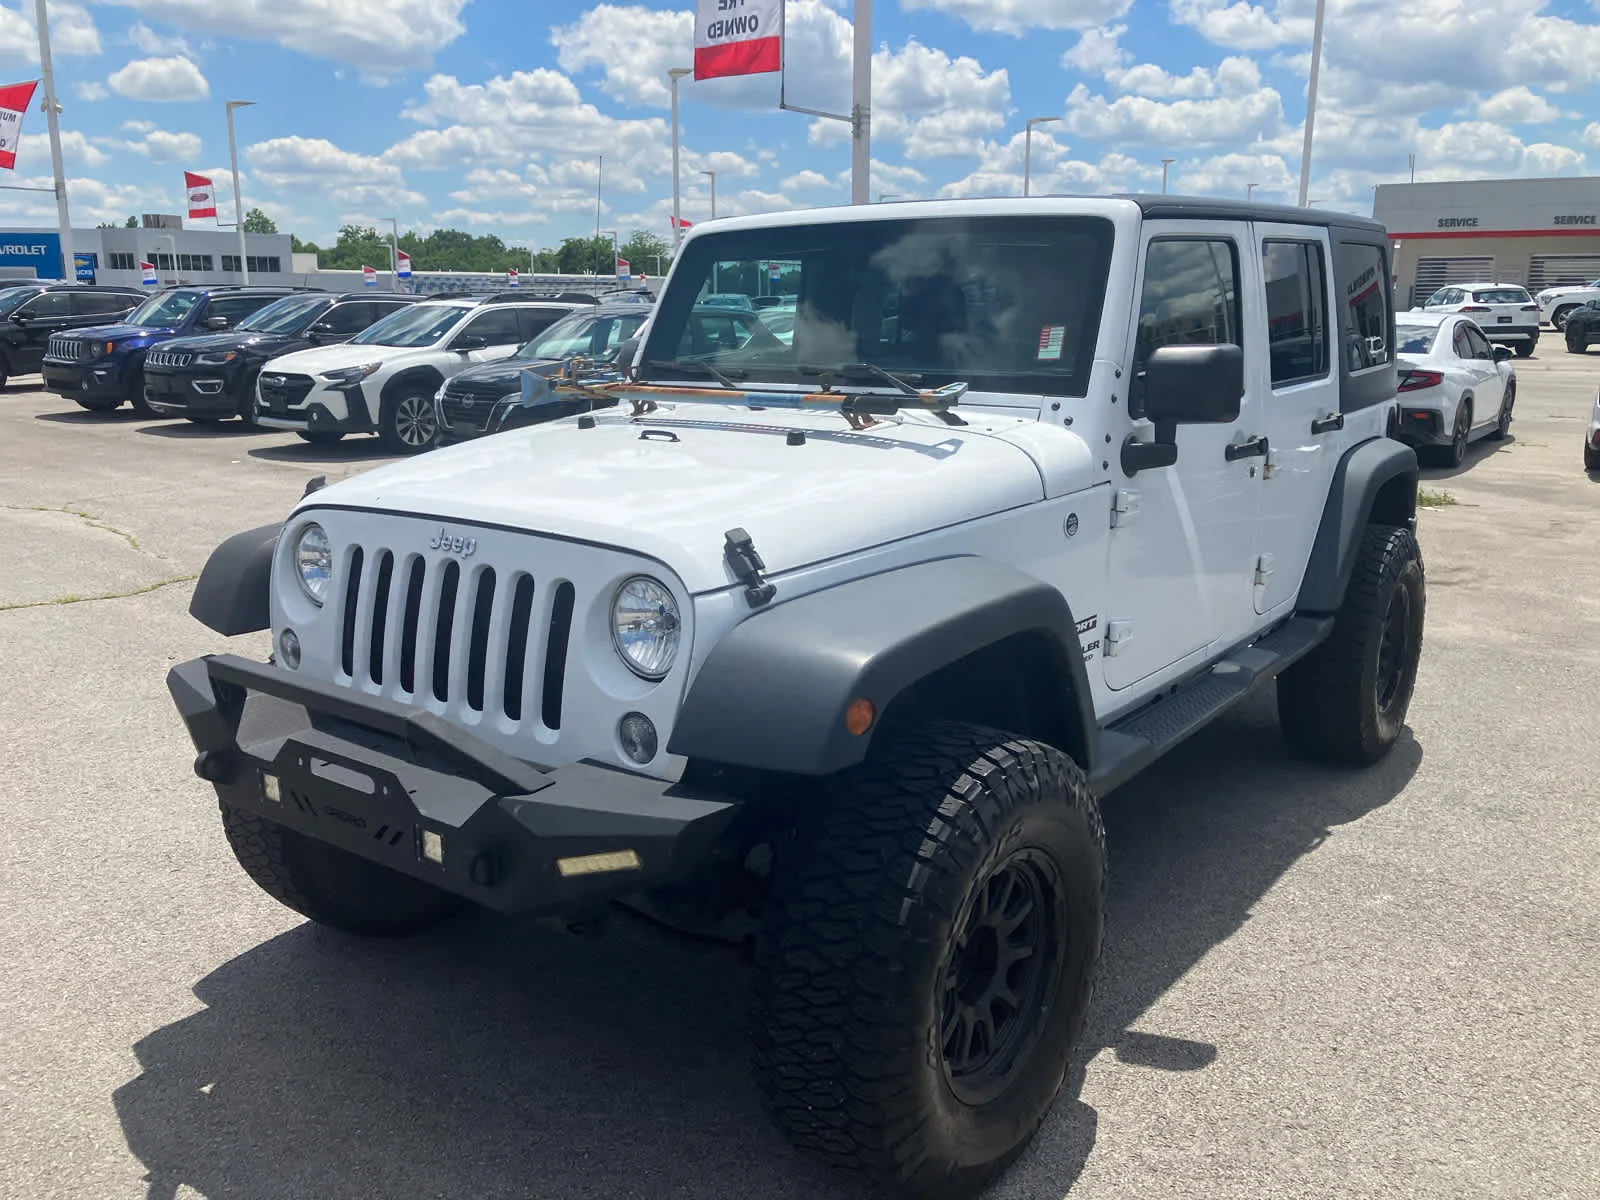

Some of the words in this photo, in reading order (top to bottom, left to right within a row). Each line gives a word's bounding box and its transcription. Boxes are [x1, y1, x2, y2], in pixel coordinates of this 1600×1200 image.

[1437, 217, 1479, 228] SERVICE
[1553, 215, 1597, 225] SERVICE
[0, 245, 47, 255] VROLET
[430, 527, 477, 560] Jeep
